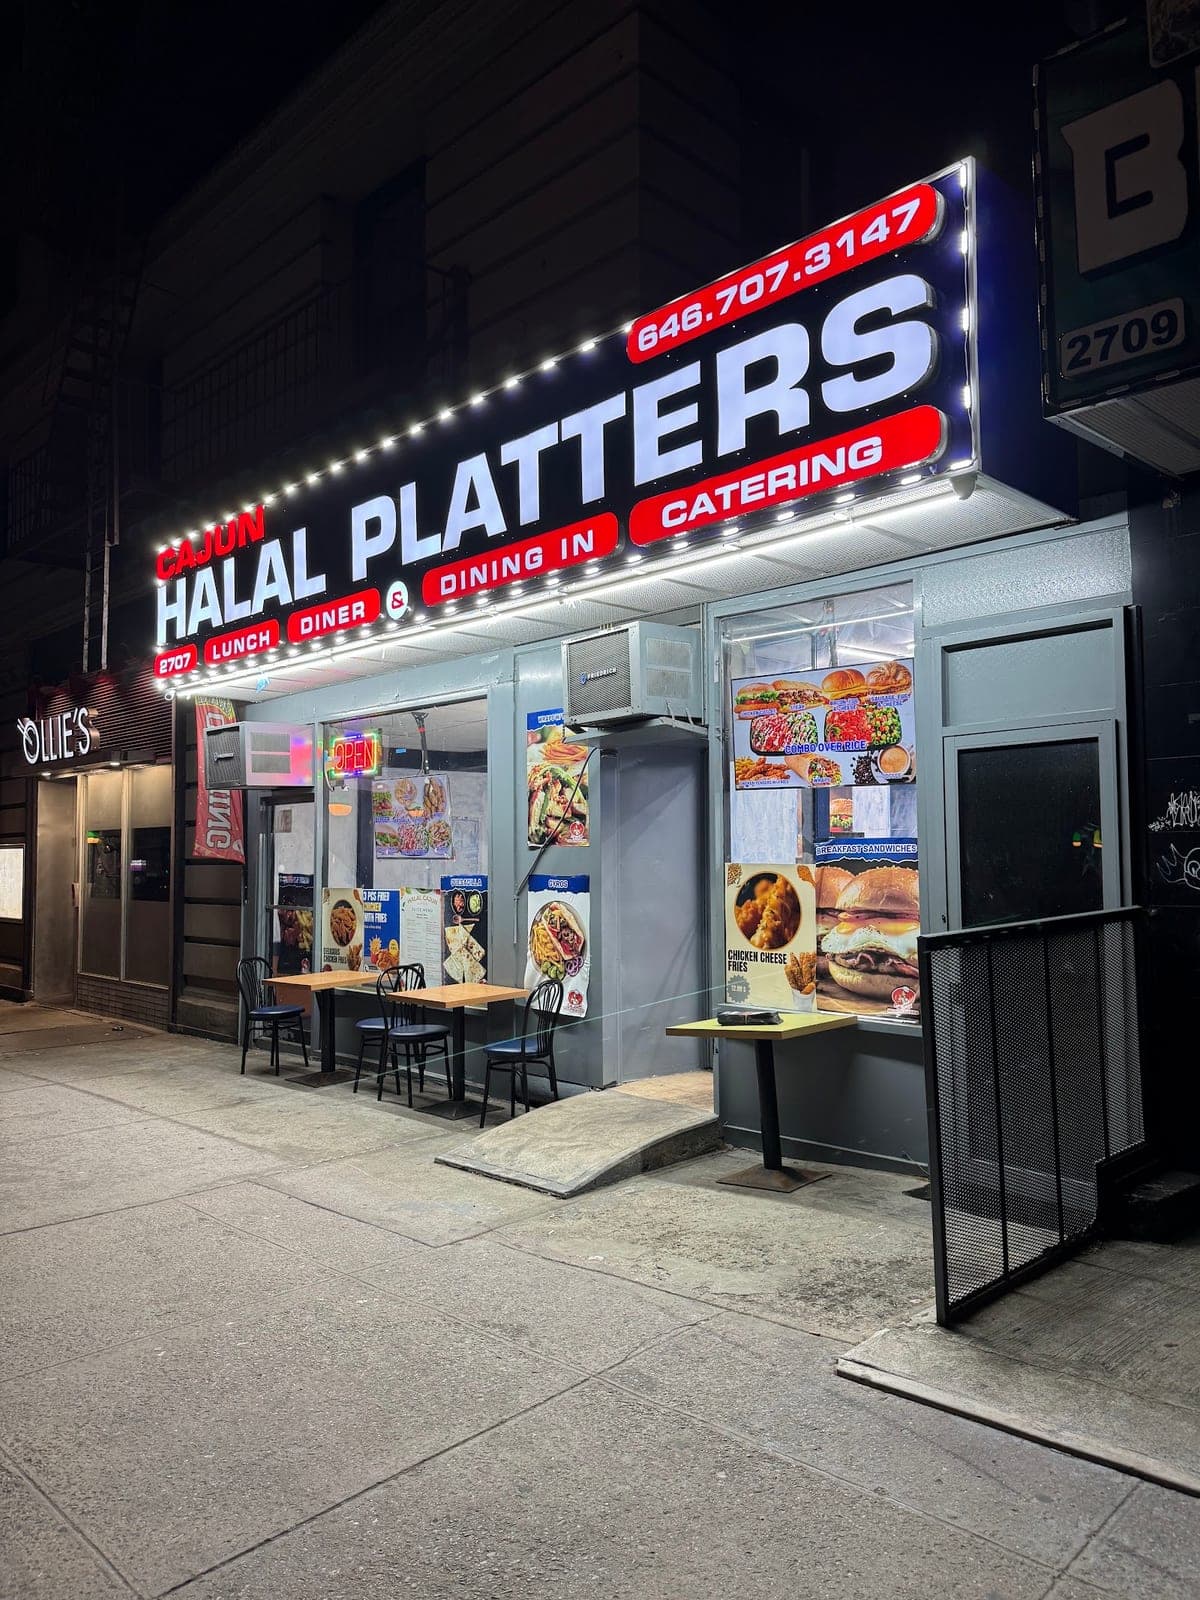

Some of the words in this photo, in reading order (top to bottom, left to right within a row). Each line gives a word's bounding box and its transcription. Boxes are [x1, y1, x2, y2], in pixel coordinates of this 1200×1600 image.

[637, 199, 922, 351] 646.707.3147
[1066, 308, 1179, 370] 2709
[157, 527, 326, 646] HALAL
[351, 274, 937, 581] PLATTERS
[662, 436, 884, 527] CATERING
[157, 504, 266, 580] CAJUN
[440, 546, 542, 597] DINING
[562, 529, 594, 560] IN
[391, 591, 404, 610] &
[301, 601, 365, 635] DINER
[213, 630, 270, 660] LUNCH
[159, 653, 191, 674] 2707
[17, 706, 93, 764] OLLIE'S
[784, 743, 817, 754] COMBO
[818, 741, 844, 752] OVER
[845, 740, 867, 751] RICE
[334, 740, 375, 770] OPEN
[816, 843, 862, 855] BREAKFAST
[863, 844, 918, 854] SANDWICHES
[548, 879, 568, 888] GYROS
[728, 949, 758, 963] CHICKEN
[760, 951, 788, 965] CHEESE
[728, 960, 748, 973] FRIES
